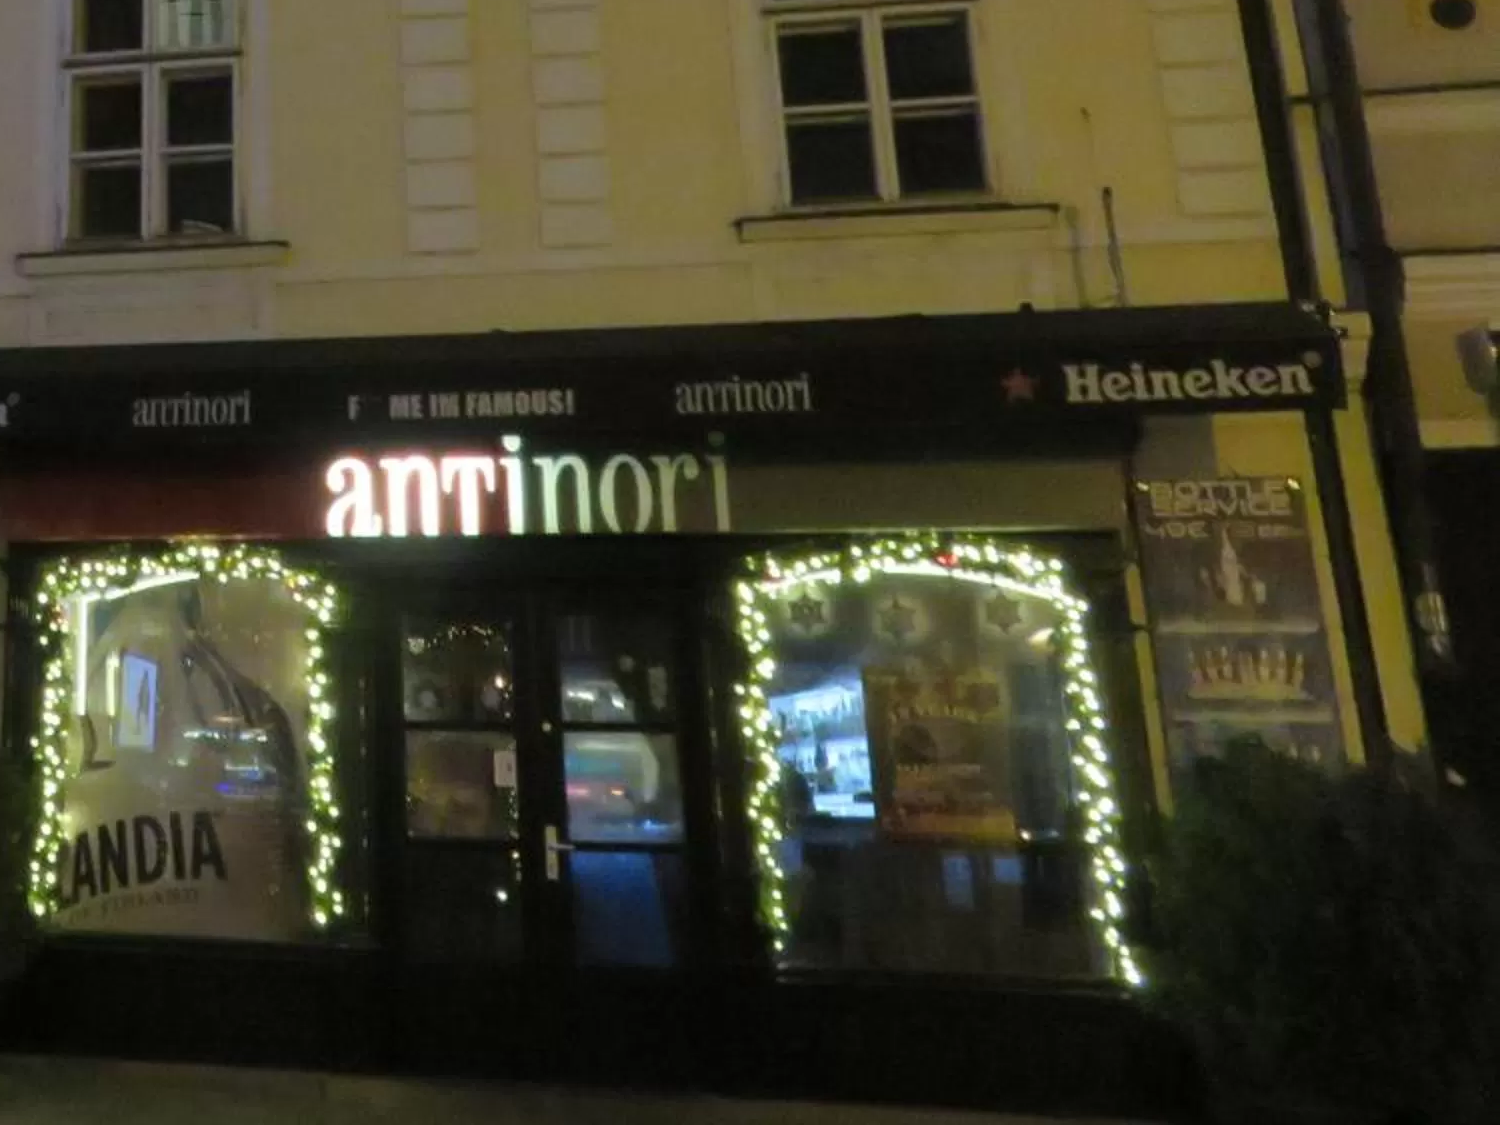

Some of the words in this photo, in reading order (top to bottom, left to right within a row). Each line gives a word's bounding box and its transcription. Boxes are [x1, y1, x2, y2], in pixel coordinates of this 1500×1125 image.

[675, 372, 815, 414] antinori
[1063, 360, 1314, 403] Heineken
[132, 389, 251, 429] antinori
[389, 393, 425, 420] ME
[464, 387, 576, 418] FAMOUS!
[327, 433, 730, 536] antinori
